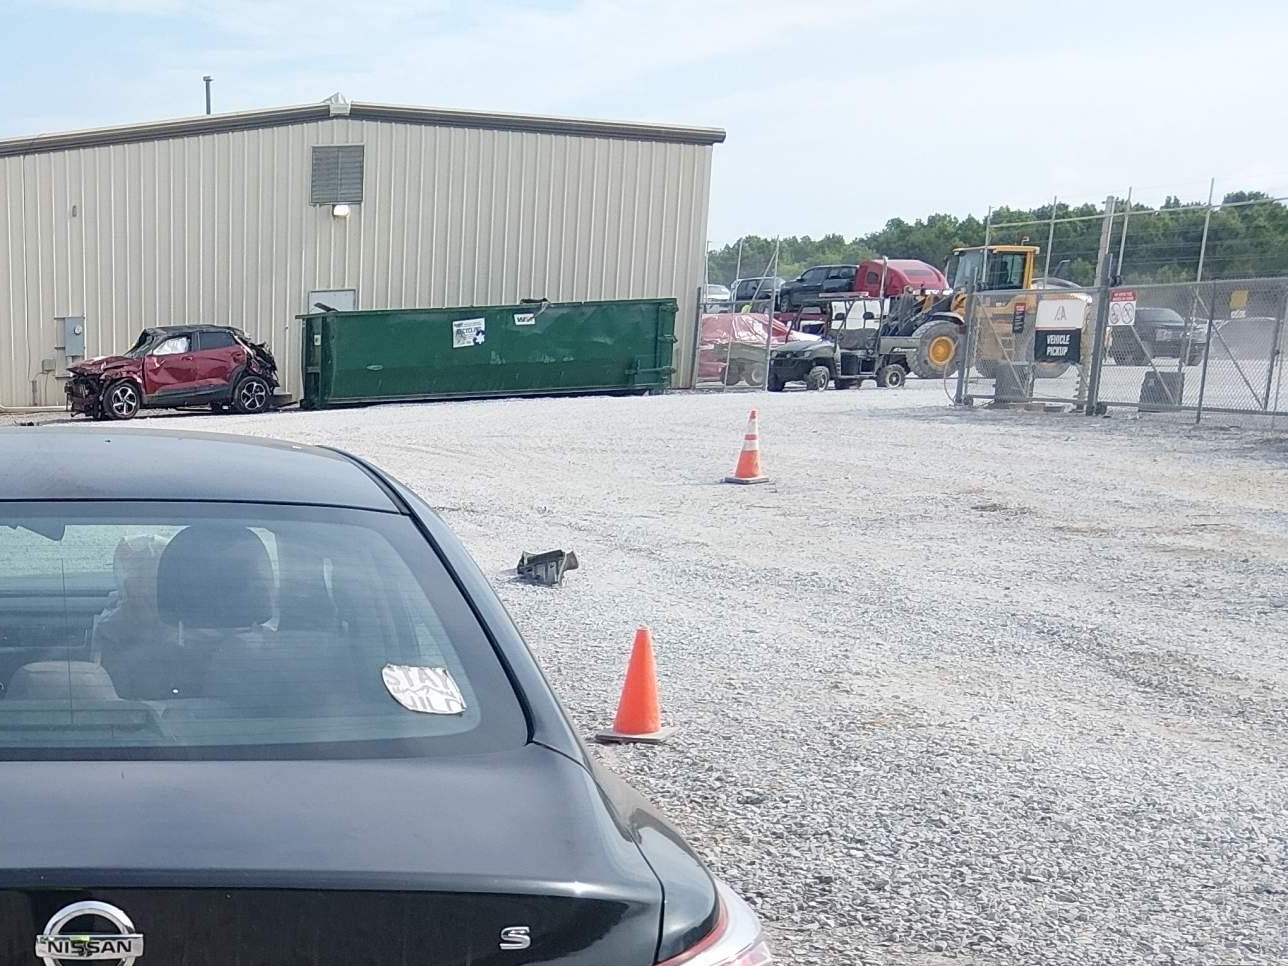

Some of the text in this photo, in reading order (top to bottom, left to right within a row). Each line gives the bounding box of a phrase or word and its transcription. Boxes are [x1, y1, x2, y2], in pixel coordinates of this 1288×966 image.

[1046, 334, 1071, 345] VEHICLE
[1046, 346, 1069, 356] PICKUP
[499, 926, 531, 950] S
[47, 940, 132, 954] NISSAN
